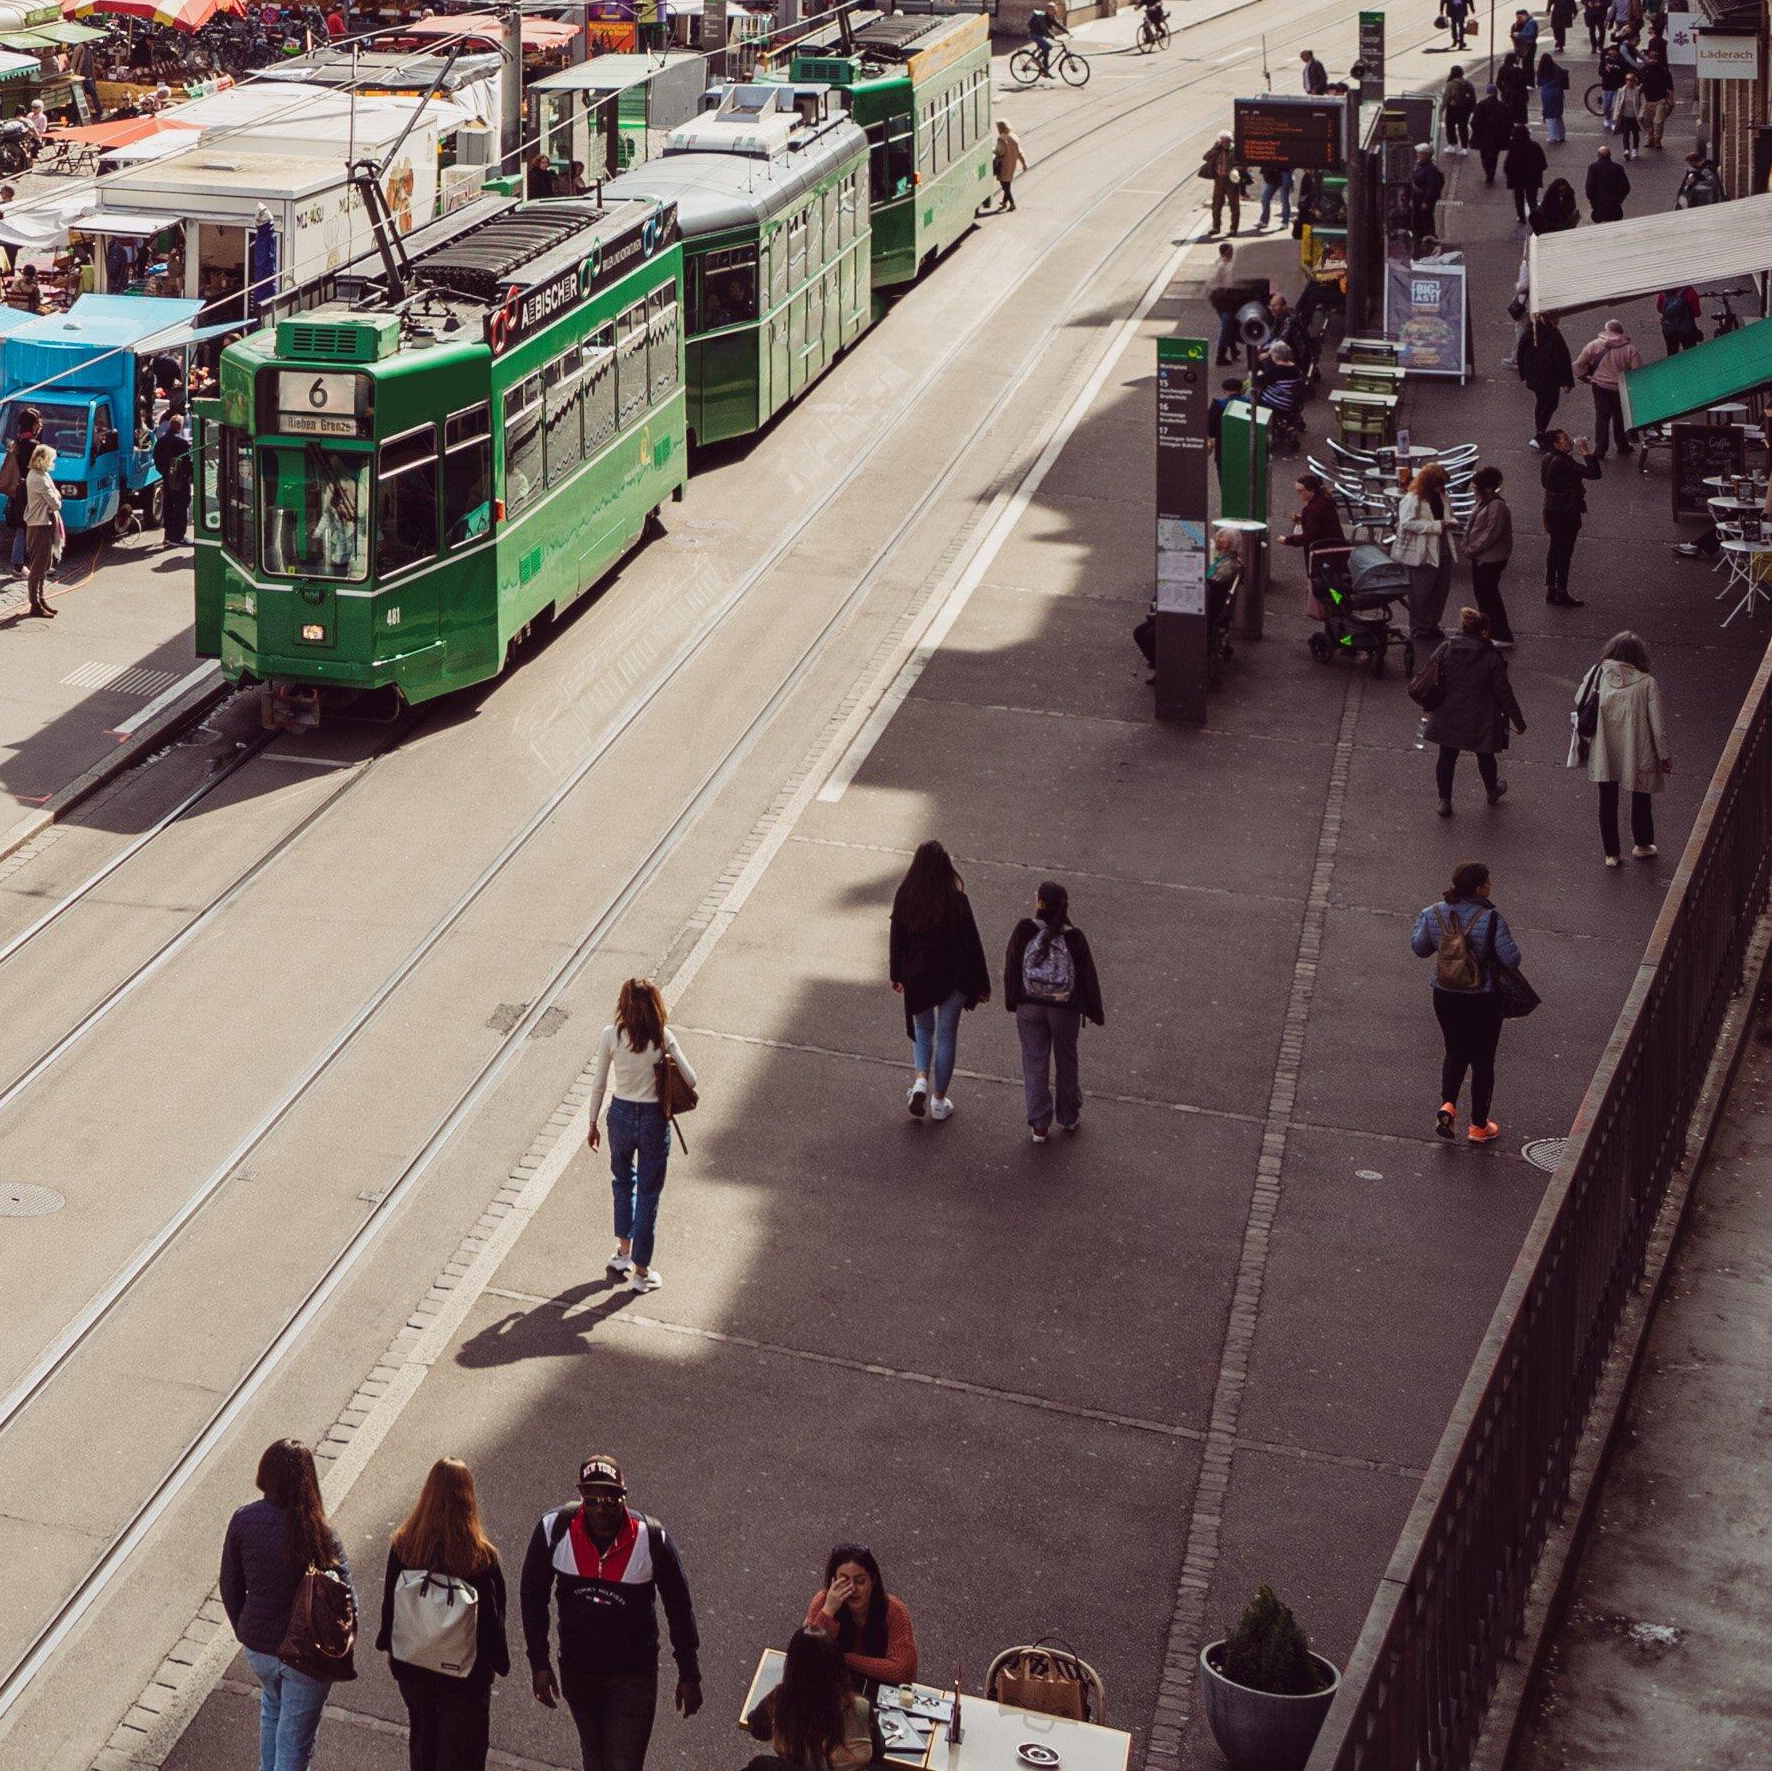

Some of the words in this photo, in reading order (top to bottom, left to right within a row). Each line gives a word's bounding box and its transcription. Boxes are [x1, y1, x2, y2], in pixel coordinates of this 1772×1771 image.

[1700, 48, 1753, 60] Läderach
[1416, 283, 1436, 295] BIG
[308, 377, 328, 409] 6
[1159, 402, 1170, 411] 16
[386, 606, 401, 627] 481
[582, 1461, 597, 1478] NEW
[596, 1461, 617, 1480] YORK
[574, 1587, 596, 1596] TOMMY
